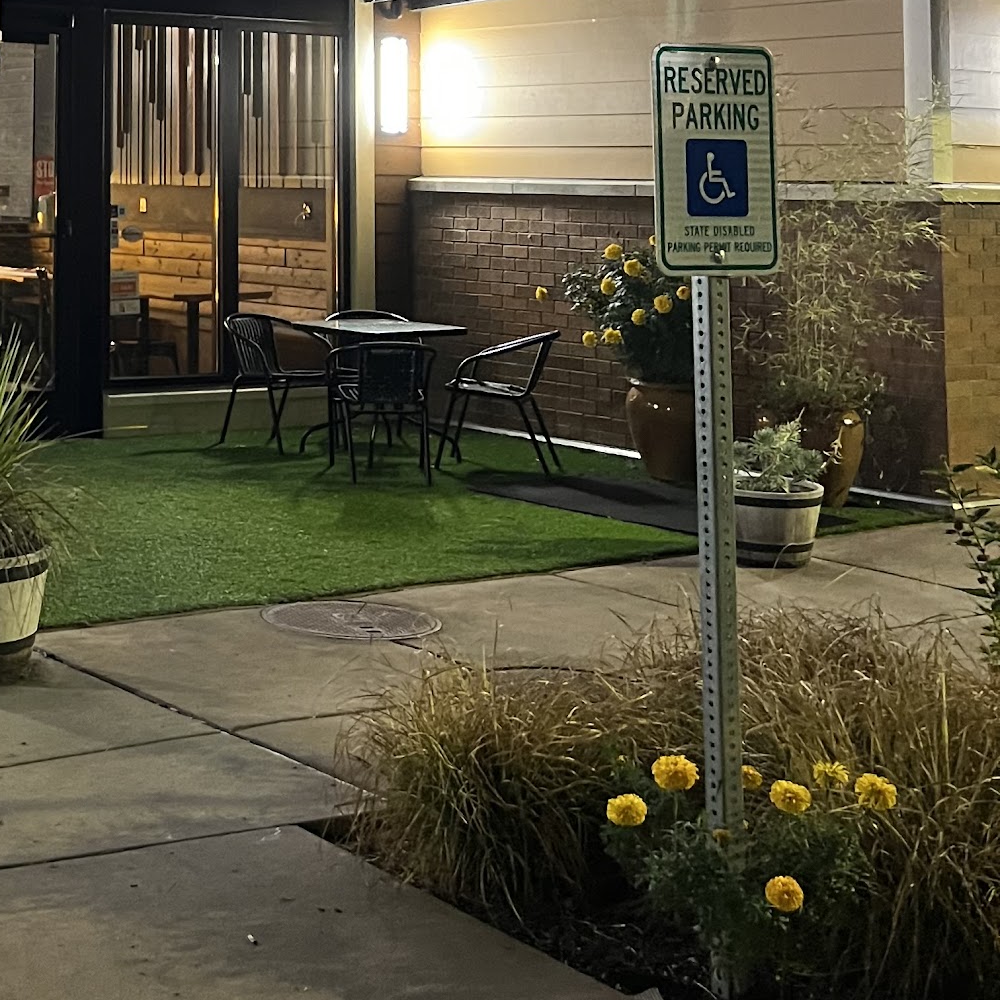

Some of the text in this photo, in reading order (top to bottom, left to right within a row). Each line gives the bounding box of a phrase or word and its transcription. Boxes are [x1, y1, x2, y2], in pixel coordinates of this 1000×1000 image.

[664, 66, 766, 96] RESERVED
[672, 102, 759, 131] PARKING
[684, 226, 755, 237] STATE DISABLED
[667, 242, 773, 253] PARKING PERMIT REQUIRED
